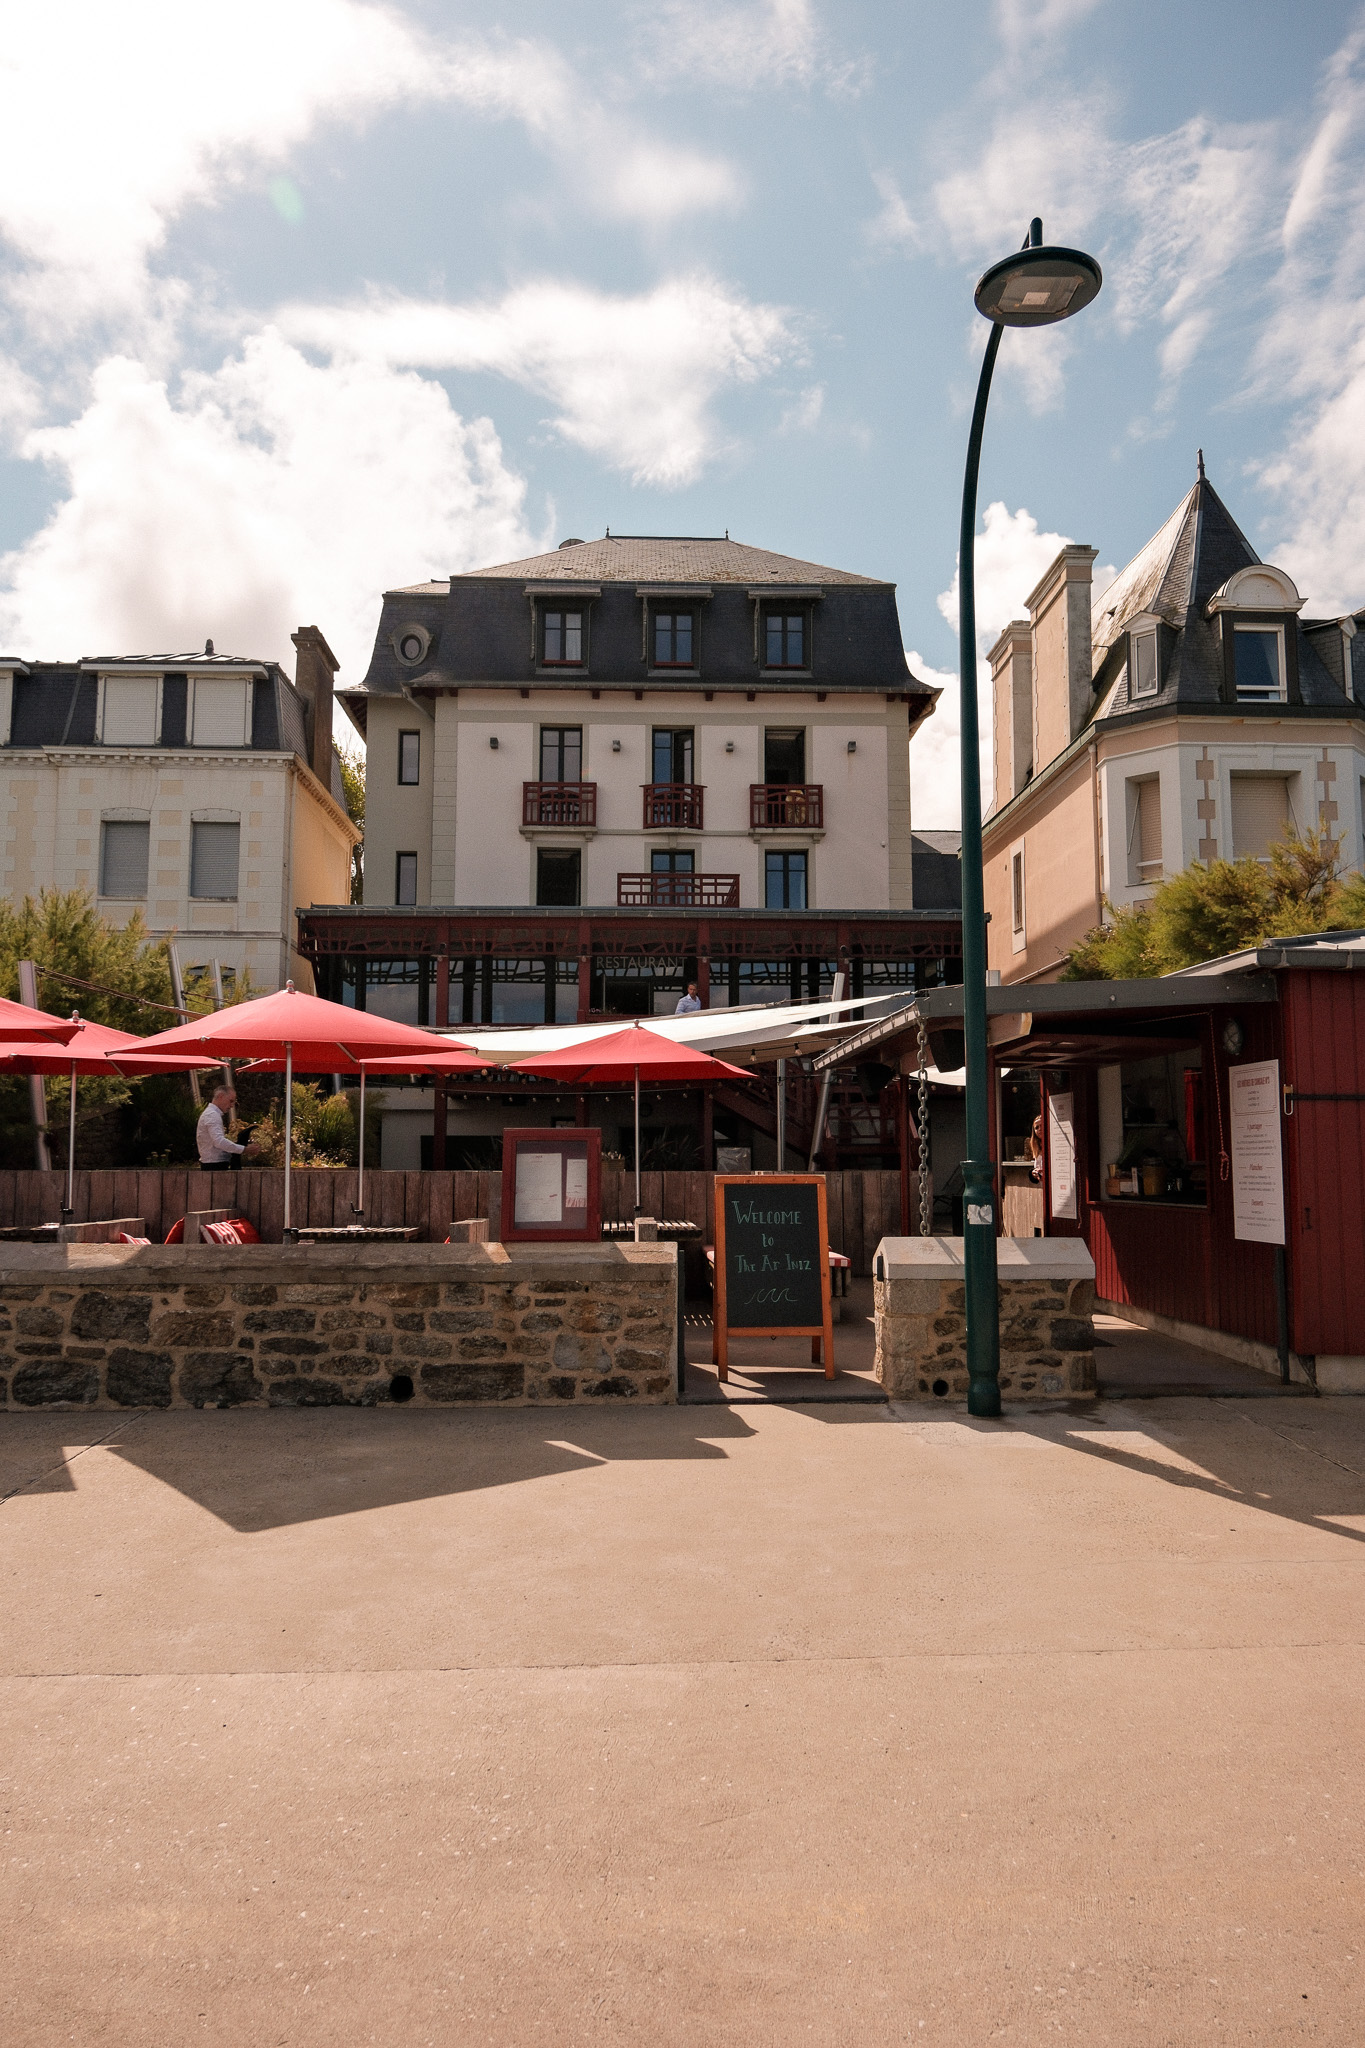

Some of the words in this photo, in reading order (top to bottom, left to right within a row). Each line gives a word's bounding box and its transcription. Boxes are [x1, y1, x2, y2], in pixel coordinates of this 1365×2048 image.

[596, 956, 688, 969] RESTAURANT
[762, 1233, 774, 1248] to
[734, 1254, 756, 1274] The
[761, 1254, 780, 1272] Ar
